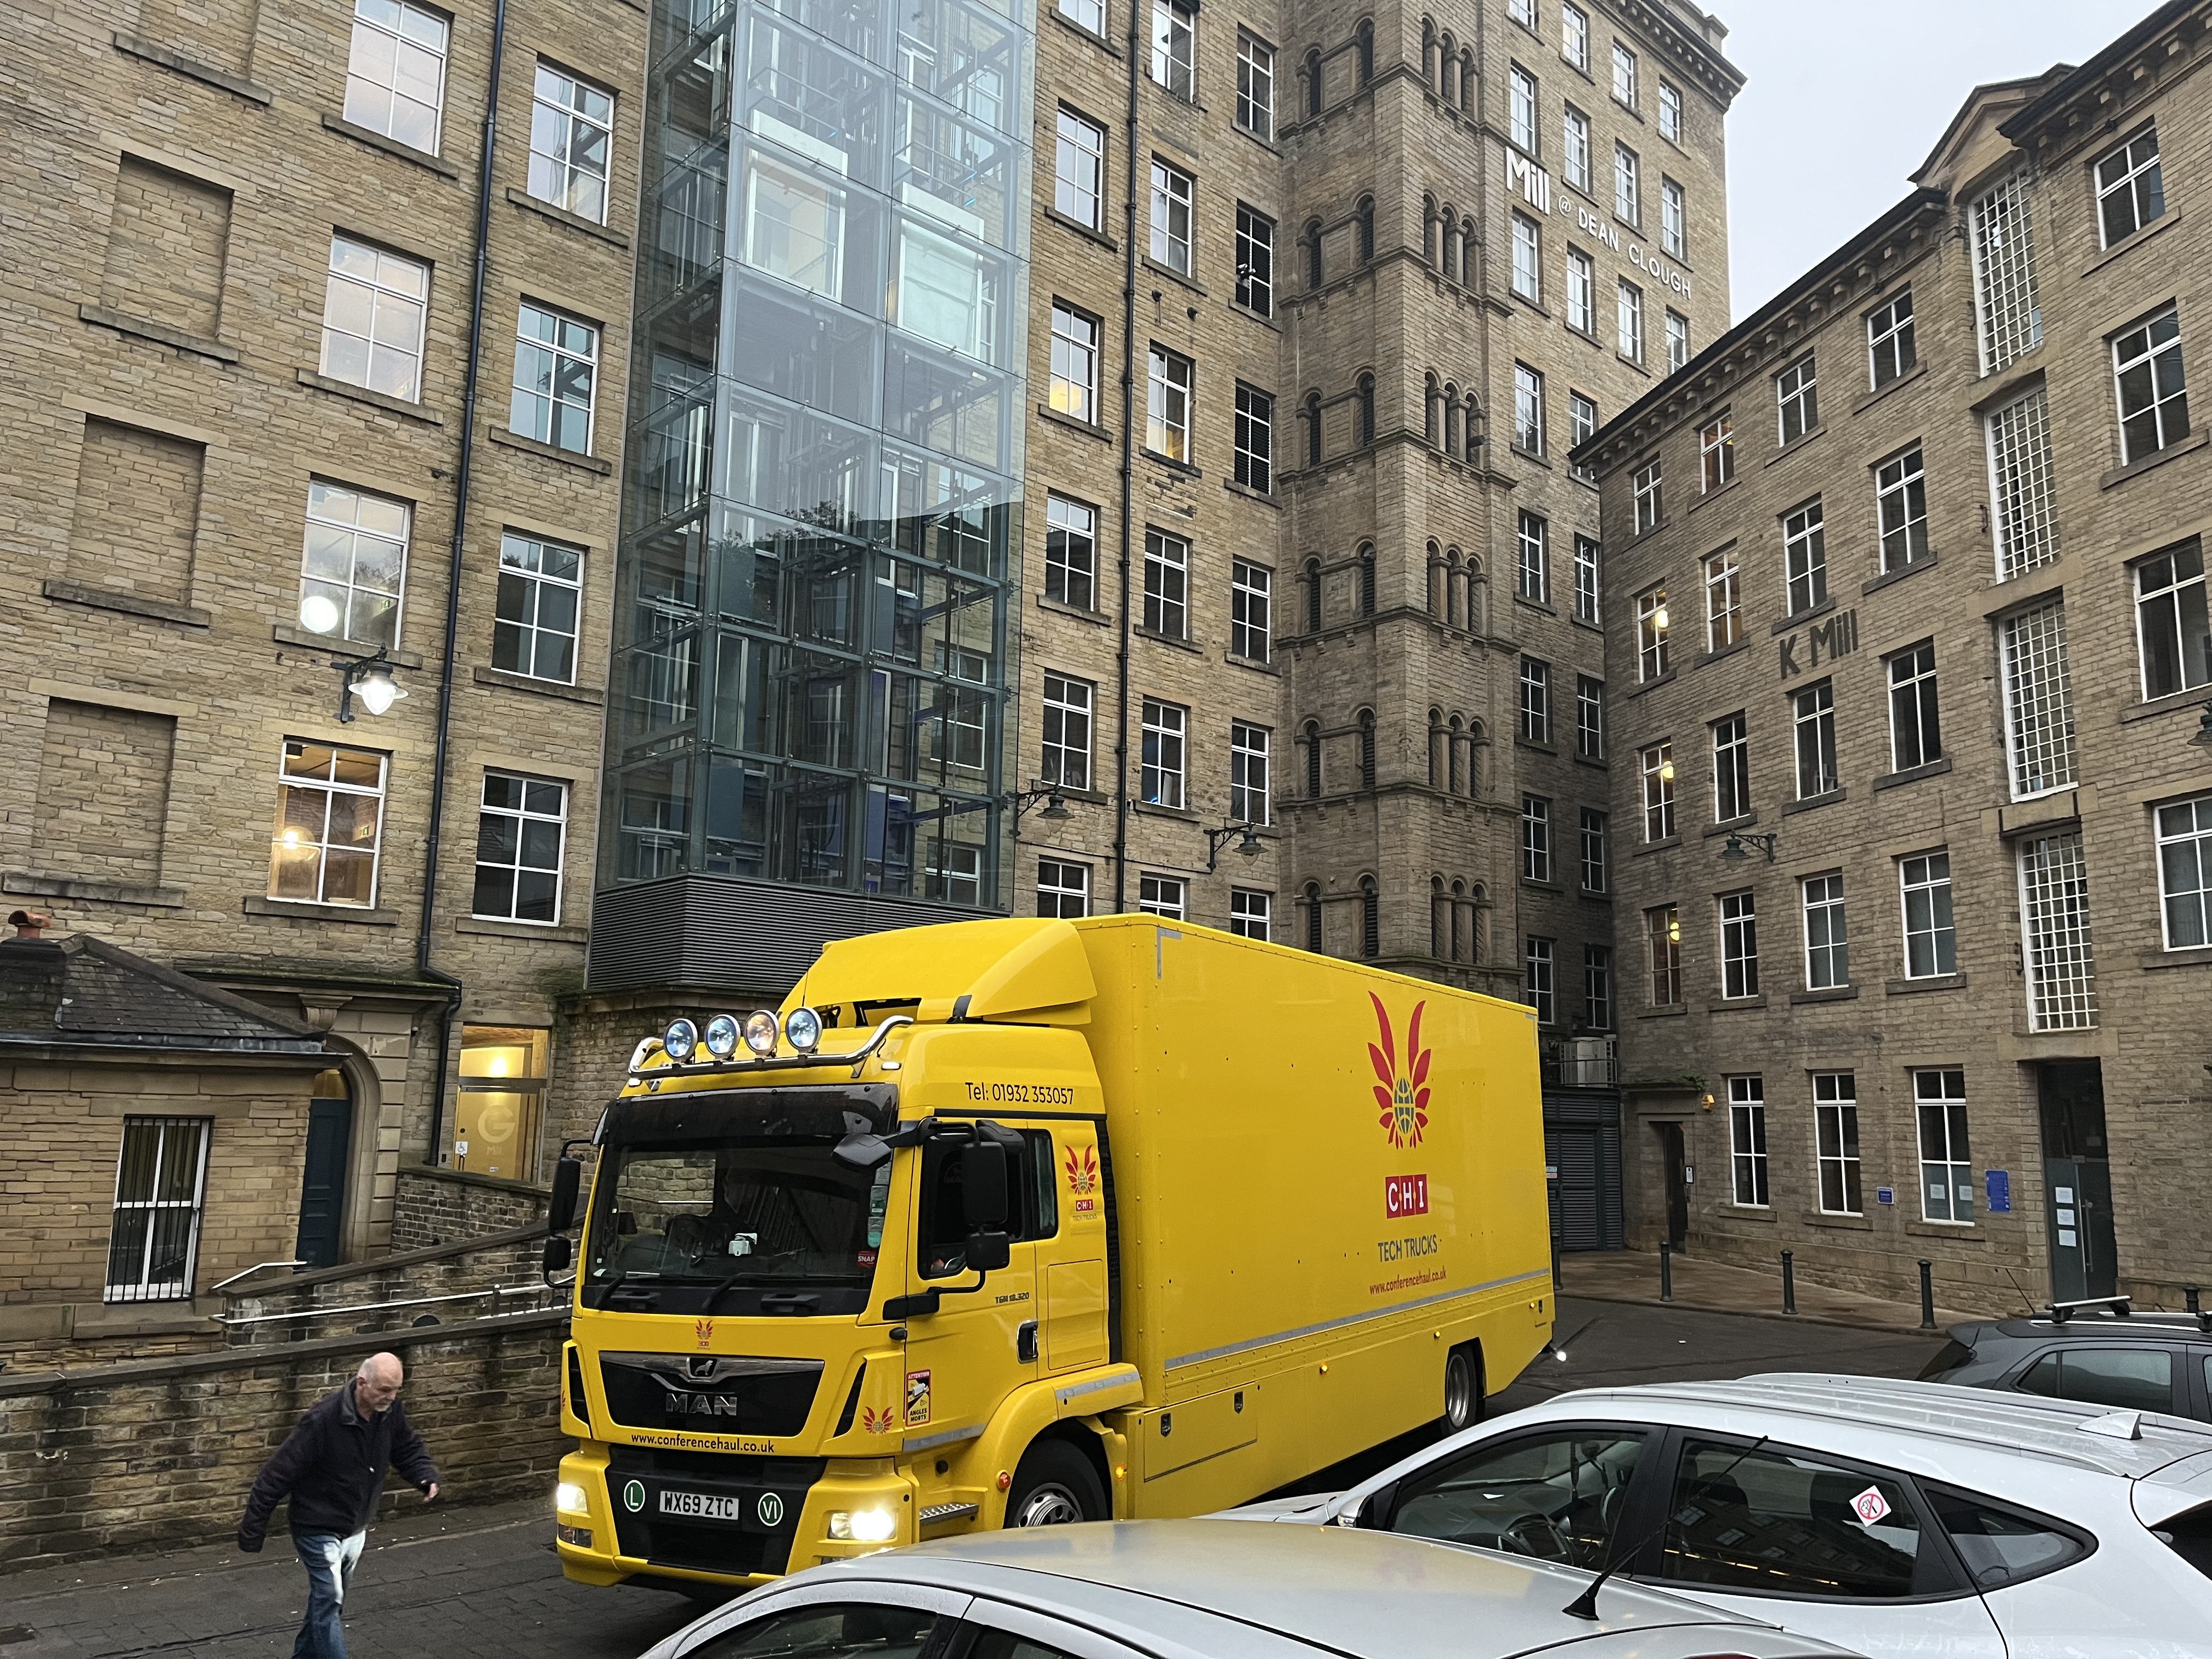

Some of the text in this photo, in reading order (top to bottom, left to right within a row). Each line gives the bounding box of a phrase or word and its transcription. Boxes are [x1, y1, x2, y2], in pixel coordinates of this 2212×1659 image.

[1505, 146, 1691, 300] Mill @ DEAN CLOUGH
[1780, 608, 1859, 680] K Mill
[965, 1082, 1074, 1105] Tel: 01932 353057
[477, 1104, 515, 1143] G
[1076, 1200, 1092, 1210] CHI
[1388, 1181, 1424, 1212] CHI
[1378, 1234, 1438, 1262] TECH TRUCKS
[1369, 1265, 1447, 1295] www.conferencehaul.co.uk
[665, 1393, 737, 1416] MAN
[910, 1408, 927, 1417] ANGLES
[631, 1433, 775, 1453] www.conferencehaul.co.uk
[630, 1487, 639, 1506] L
[664, 1492, 733, 1517] WX69 ZTC
[763, 1500, 777, 1520] VI
